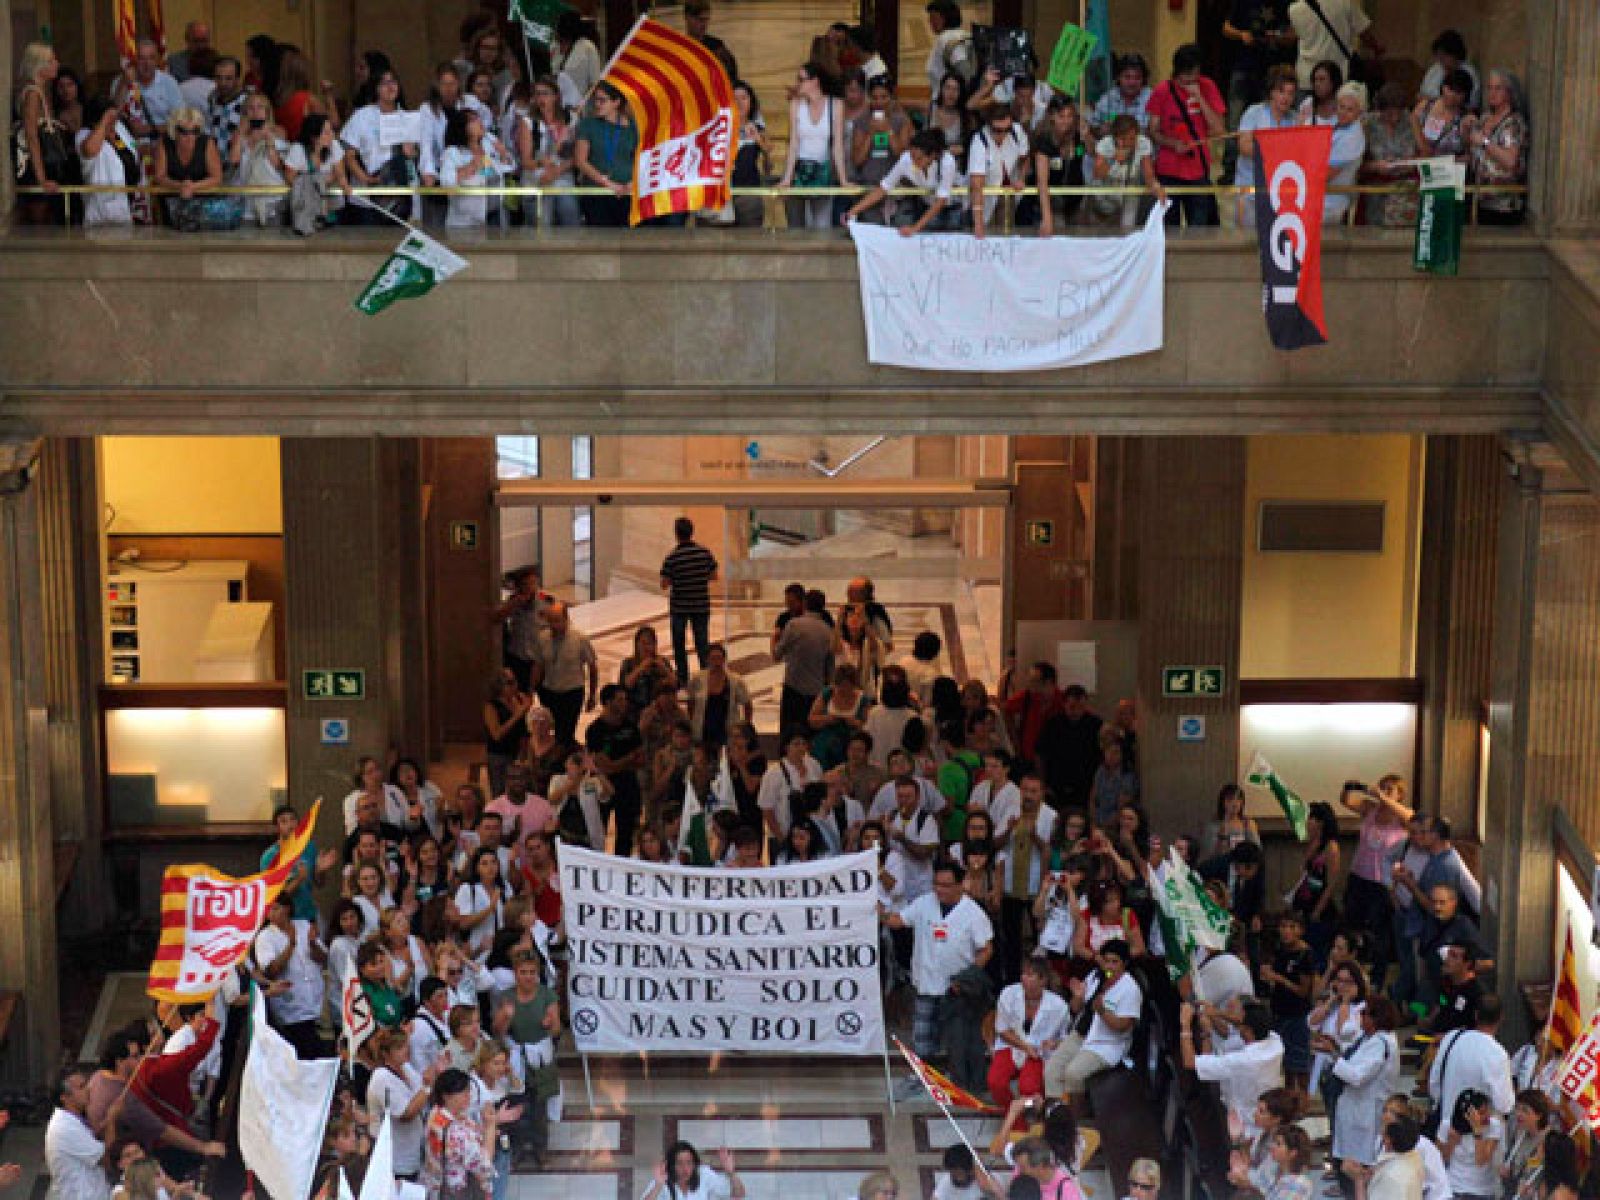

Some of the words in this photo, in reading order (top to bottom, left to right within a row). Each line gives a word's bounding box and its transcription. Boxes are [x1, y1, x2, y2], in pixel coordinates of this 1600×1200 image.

[565, 865, 614, 893] TU
[624, 869, 873, 899] ENFERMEDAD
[577, 903, 787, 936] PERJUDICA
[804, 906, 852, 931] EL
[704, 944, 877, 970] SANITARIO
[570, 974, 726, 1002] CUIDATE
[751, 1016, 817, 1041] BOI
